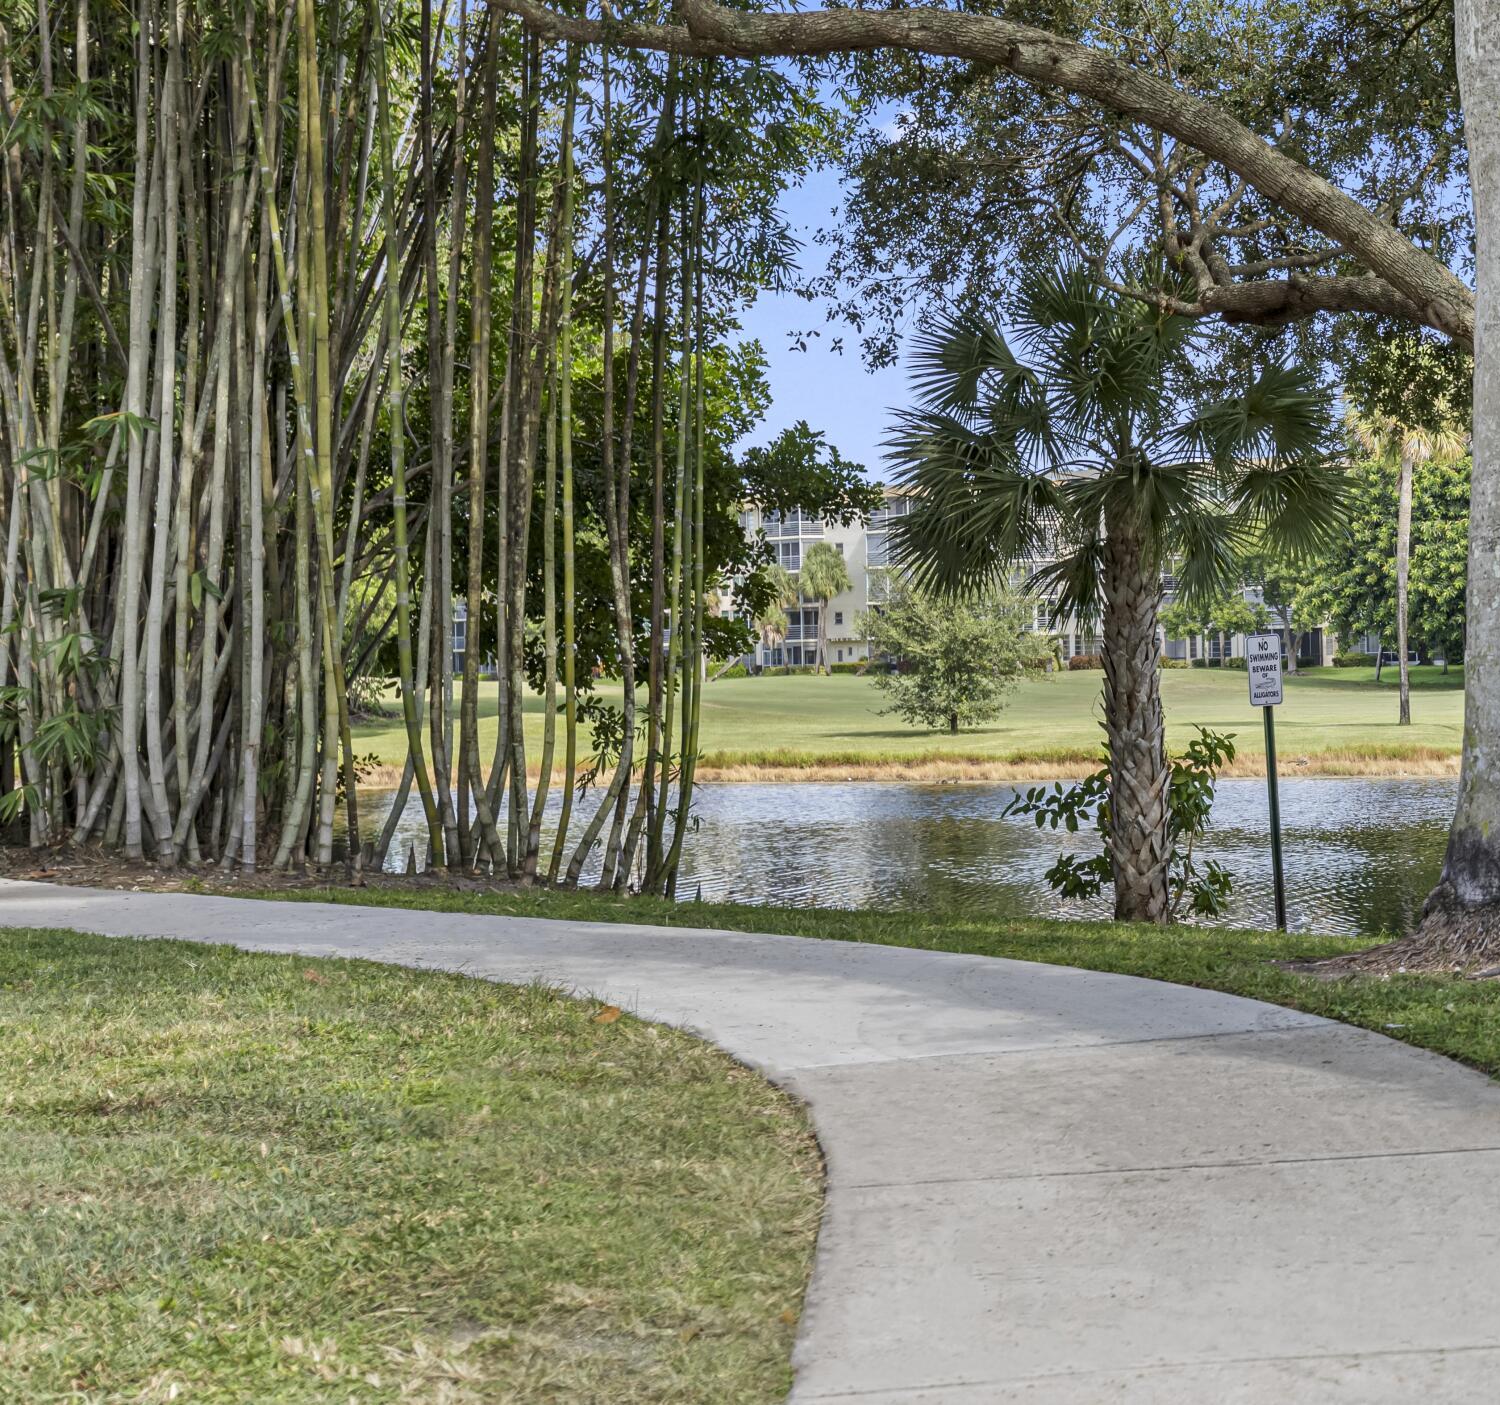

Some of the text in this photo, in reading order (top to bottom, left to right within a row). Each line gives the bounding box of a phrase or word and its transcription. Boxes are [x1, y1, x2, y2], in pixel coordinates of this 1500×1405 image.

[1258, 641, 1268, 651] NO
[1250, 652, 1278, 662] SWIMMING
[1252, 664, 1277, 673] BEWARE
[1254, 690, 1279, 698] ALLIGATORS
